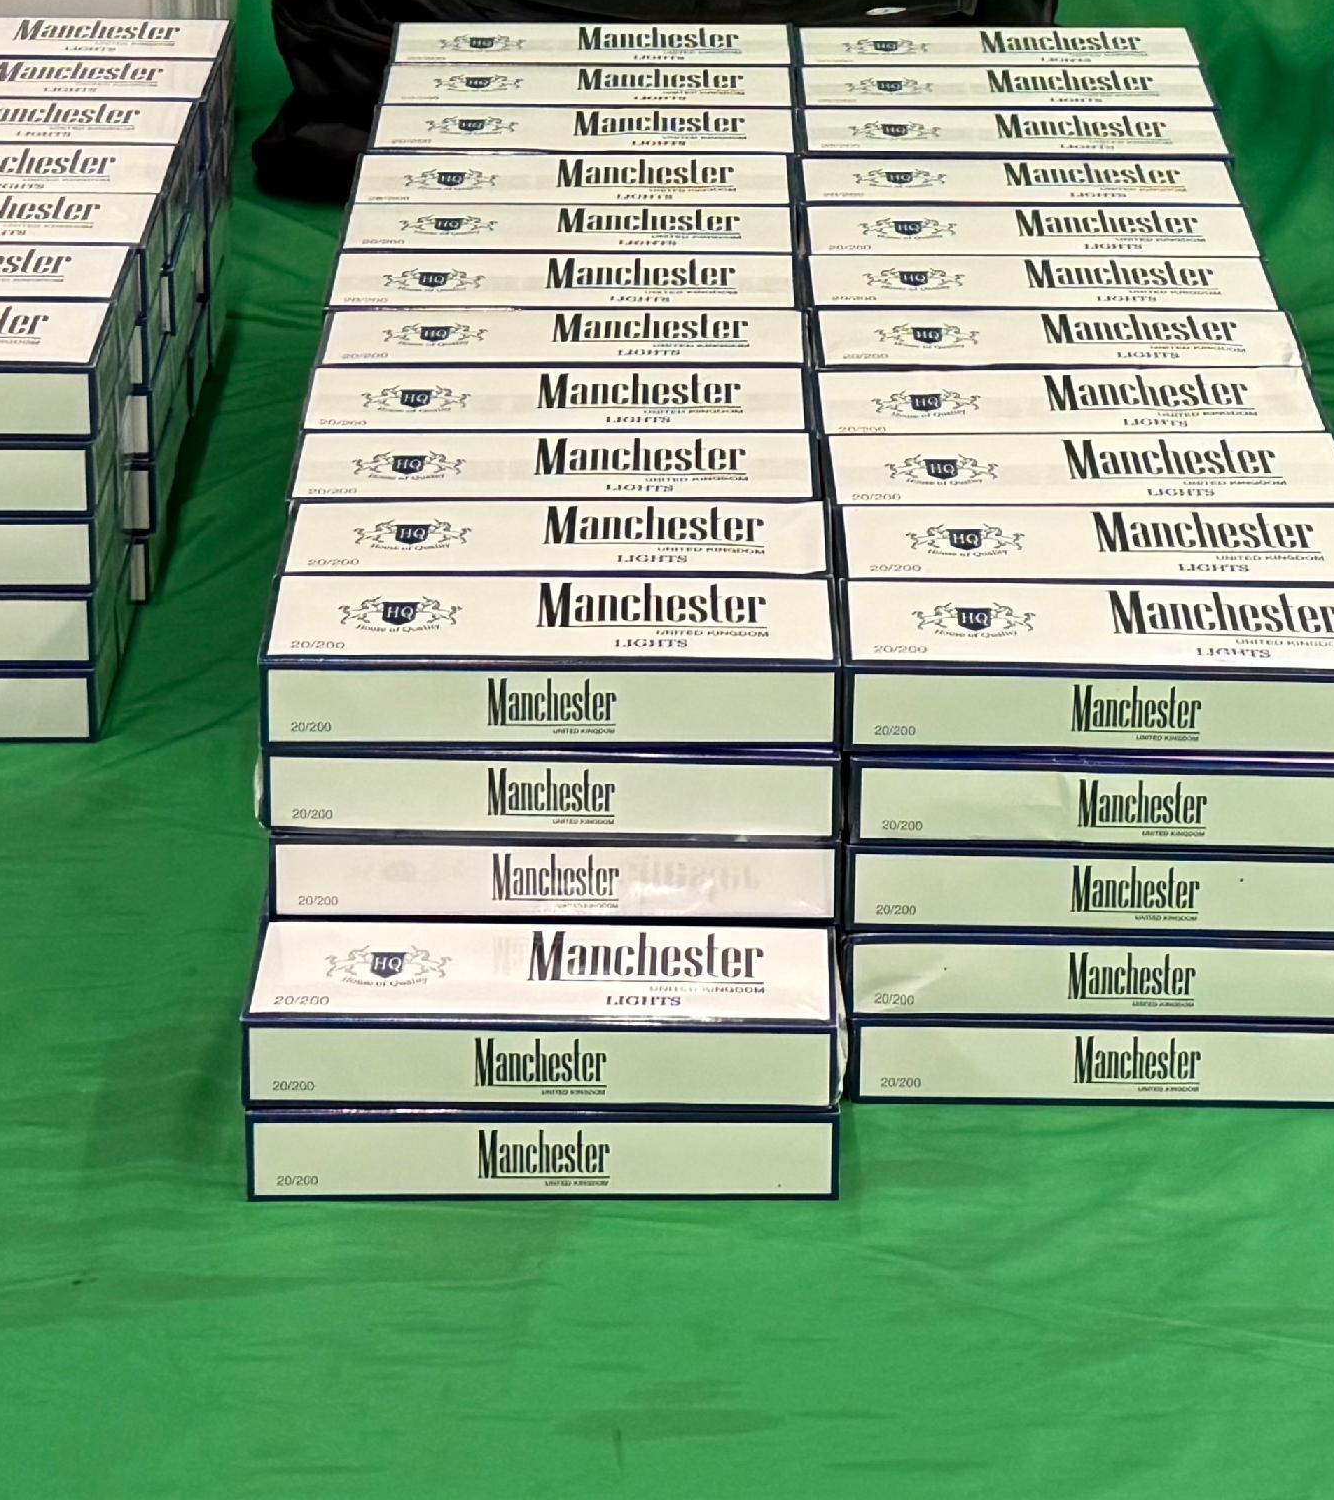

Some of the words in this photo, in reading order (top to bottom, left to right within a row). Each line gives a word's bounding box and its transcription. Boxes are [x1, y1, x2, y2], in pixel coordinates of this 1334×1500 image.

[12, 19, 181, 41] Manchester
[577, 26, 739, 50] Manchester
[979, 31, 1141, 53] Manchester
[577, 68, 744, 90] Manchester
[986, 69, 1154, 93] Manchester
[574, 110, 746, 136] Manchester
[994, 113, 1167, 138] Manchester
[556, 159, 735, 187] Manchester
[1003, 162, 1181, 186] Manchester
[557, 207, 741, 233] Manchester
[1015, 209, 1198, 237] Manchester
[544, 257, 736, 289] Manchester
[1024, 259, 1214, 289] Manchester
[552, 313, 749, 342] Manchester
[1041, 313, 1237, 344] Manchester
[537, 373, 741, 409] Manchester
[1042, 374, 1248, 411] Manchester
[1123, 419, 1188, 427] LIGHTS
[534, 437, 746, 475] Manchester
[1062, 439, 1276, 479] Manchester
[606, 484, 674, 492] LIGHTS
[1147, 488, 1216, 496] LIGHTS
[399, 528, 426, 539] HQ
[542, 505, 765, 544] Manchester
[1091, 511, 1314, 552] Manchester
[953, 533, 980, 545] HQ
[307, 558, 360, 566] 20/200
[617, 554, 688, 563] LIGHTS
[1178, 563, 1250, 572] LIGHTS
[386, 605, 414, 618] HQ
[535, 582, 766, 628] Manchester
[961, 612, 988, 625] HQ
[290, 640, 346, 650] 20/200
[615, 639, 688, 648] LIGHTS
[1196, 647, 1271, 658] LIGHTS
[487, 677, 617, 726] Manchester
[1071, 684, 1202, 733] Manchester
[290, 721, 332, 732] 20/200
[874, 725, 916, 736] 20/200
[487, 767, 615, 816] Manchester
[1077, 779, 1207, 827] Manchester
[292, 809, 333, 820] 20/200
[882, 819, 923, 831] 20/200
[492, 853, 620, 900] Manchester
[1070, 865, 1200, 912] Manchester
[298, 895, 339, 906] 20/200
[876, 904, 916, 915] 20/200
[373, 957, 402, 971] HQ
[527, 930, 764, 981] Manchester
[1068, 952, 1196, 999] Manchester
[273, 995, 330, 1006] 20/200
[606, 995, 681, 1006] LIGHTS
[874, 993, 914, 1005] 20/200
[474, 1037, 607, 1087] Manchester
[1073, 1036, 1201, 1084] Manchester
[272, 1080, 315, 1092] 20/200
[880, 1077, 921, 1089] 20/200
[478, 1129, 610, 1179] Manchester
[277, 1175, 319, 1187] 20/200
